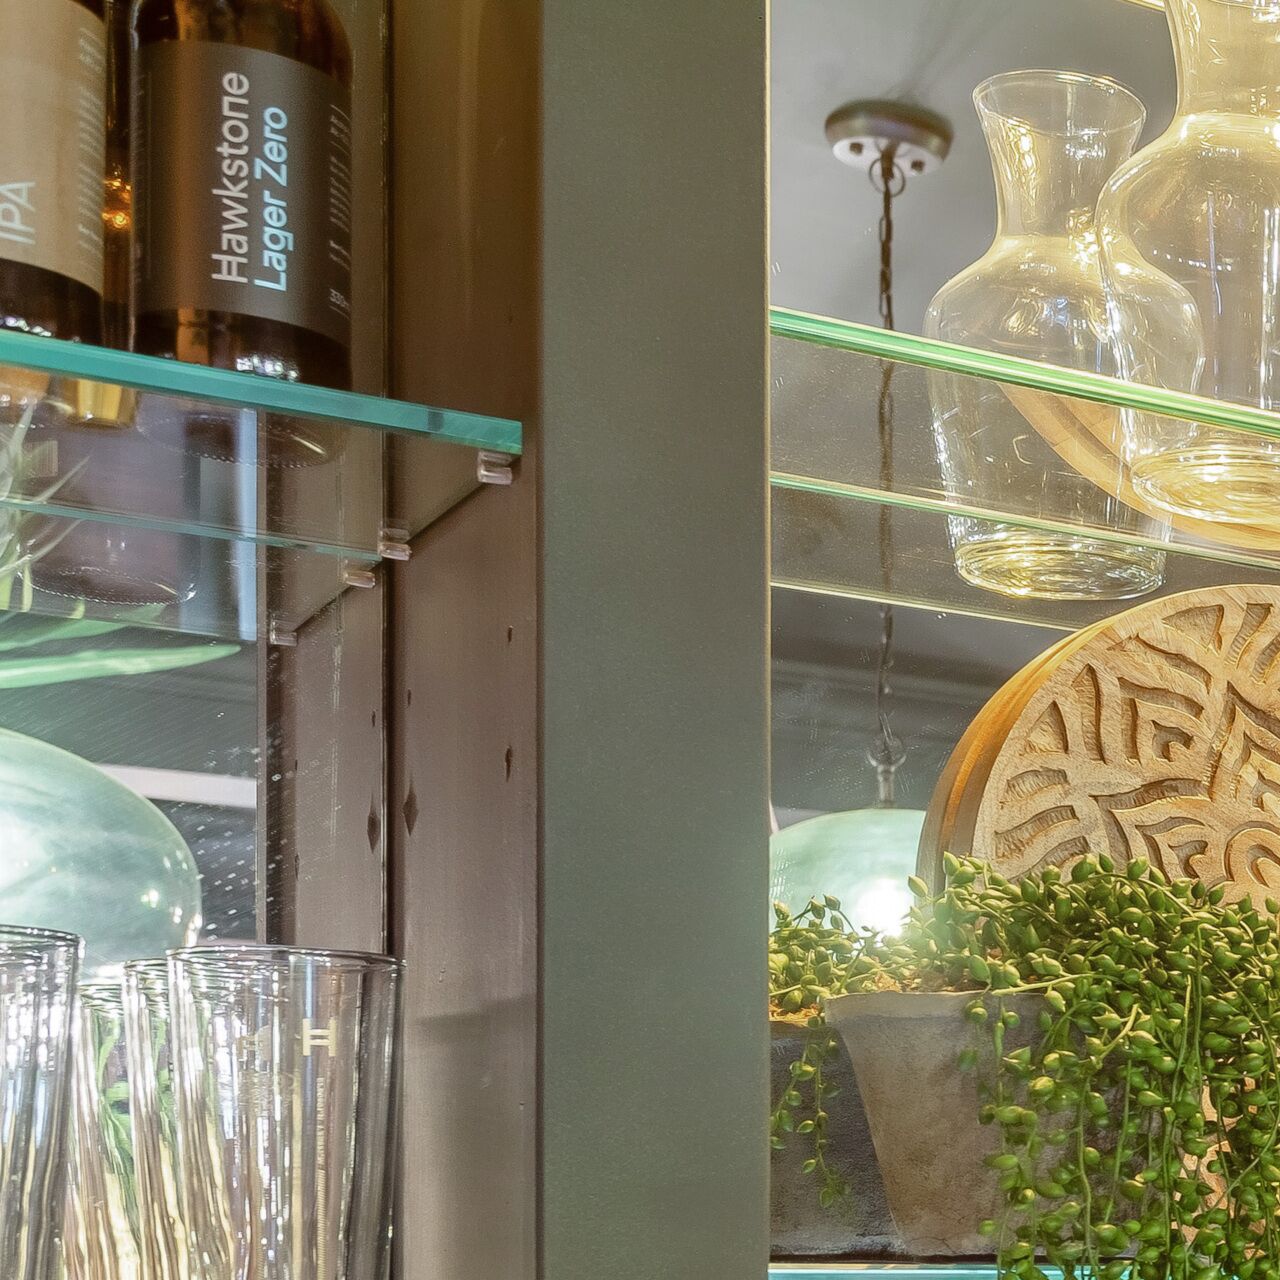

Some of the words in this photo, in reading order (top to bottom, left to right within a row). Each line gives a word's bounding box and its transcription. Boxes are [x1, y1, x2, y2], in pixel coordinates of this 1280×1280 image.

[211, 72, 250, 284] Hawkstone
[255, 106, 289, 187] Zero
[254, 190, 294, 292] Lager
